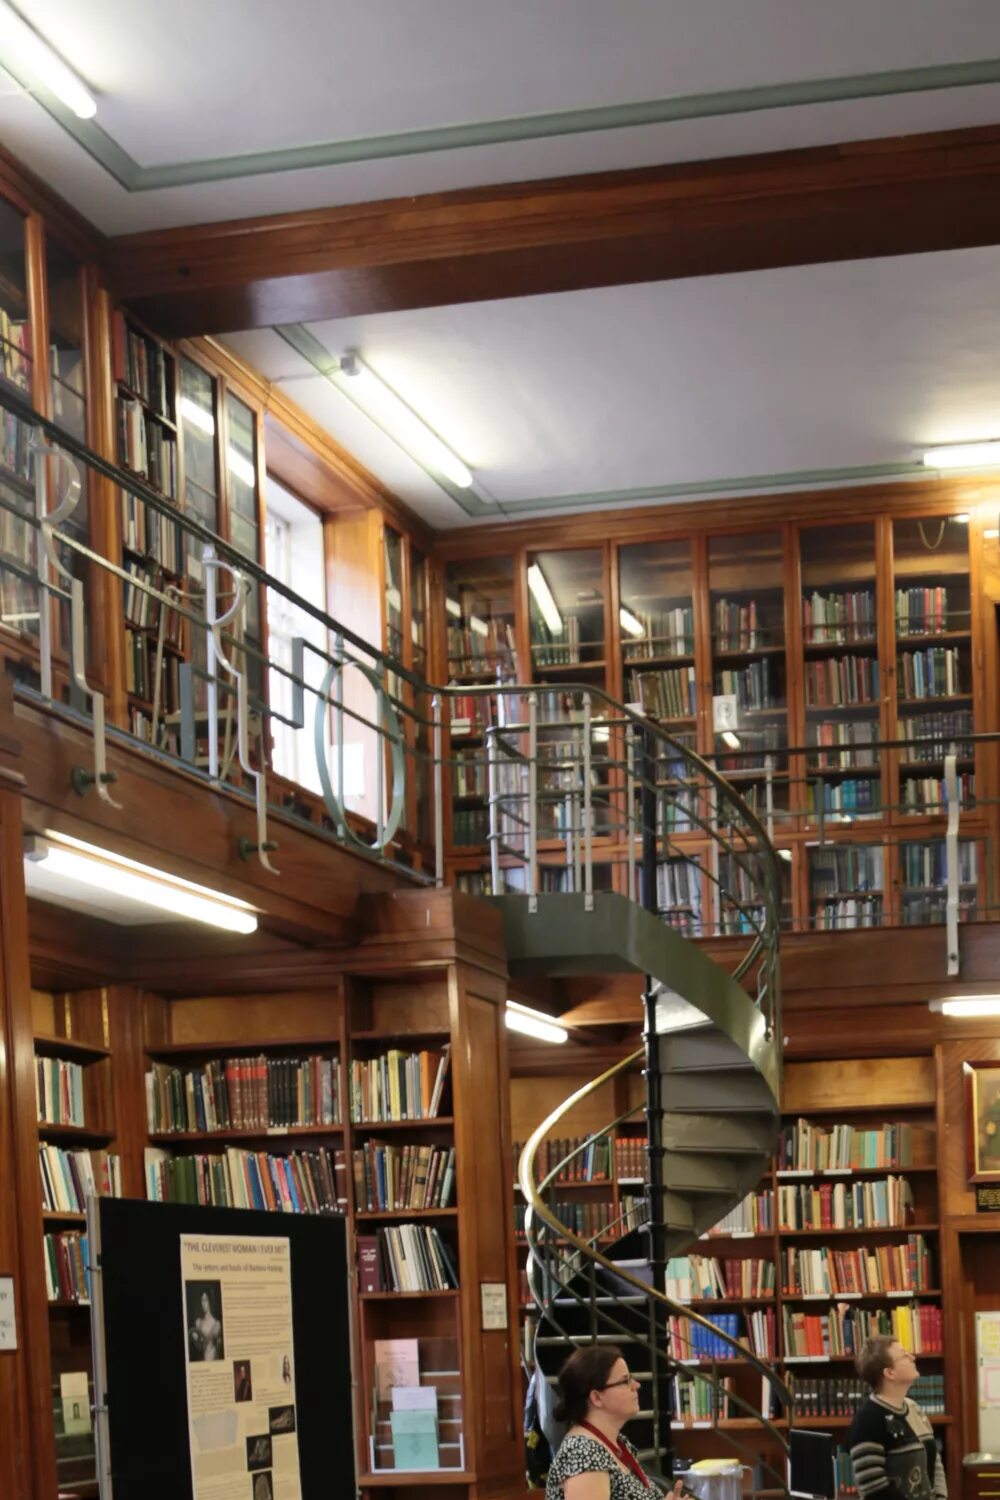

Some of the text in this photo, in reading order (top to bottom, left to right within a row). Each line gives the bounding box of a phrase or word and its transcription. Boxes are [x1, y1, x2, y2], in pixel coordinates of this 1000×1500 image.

[201, 1243, 231, 1253] CLEVEREST
[232, 1243, 257, 1253] WOMAN
[261, 1244, 273, 1254] EVER
[192, 1262, 202, 1271] The
